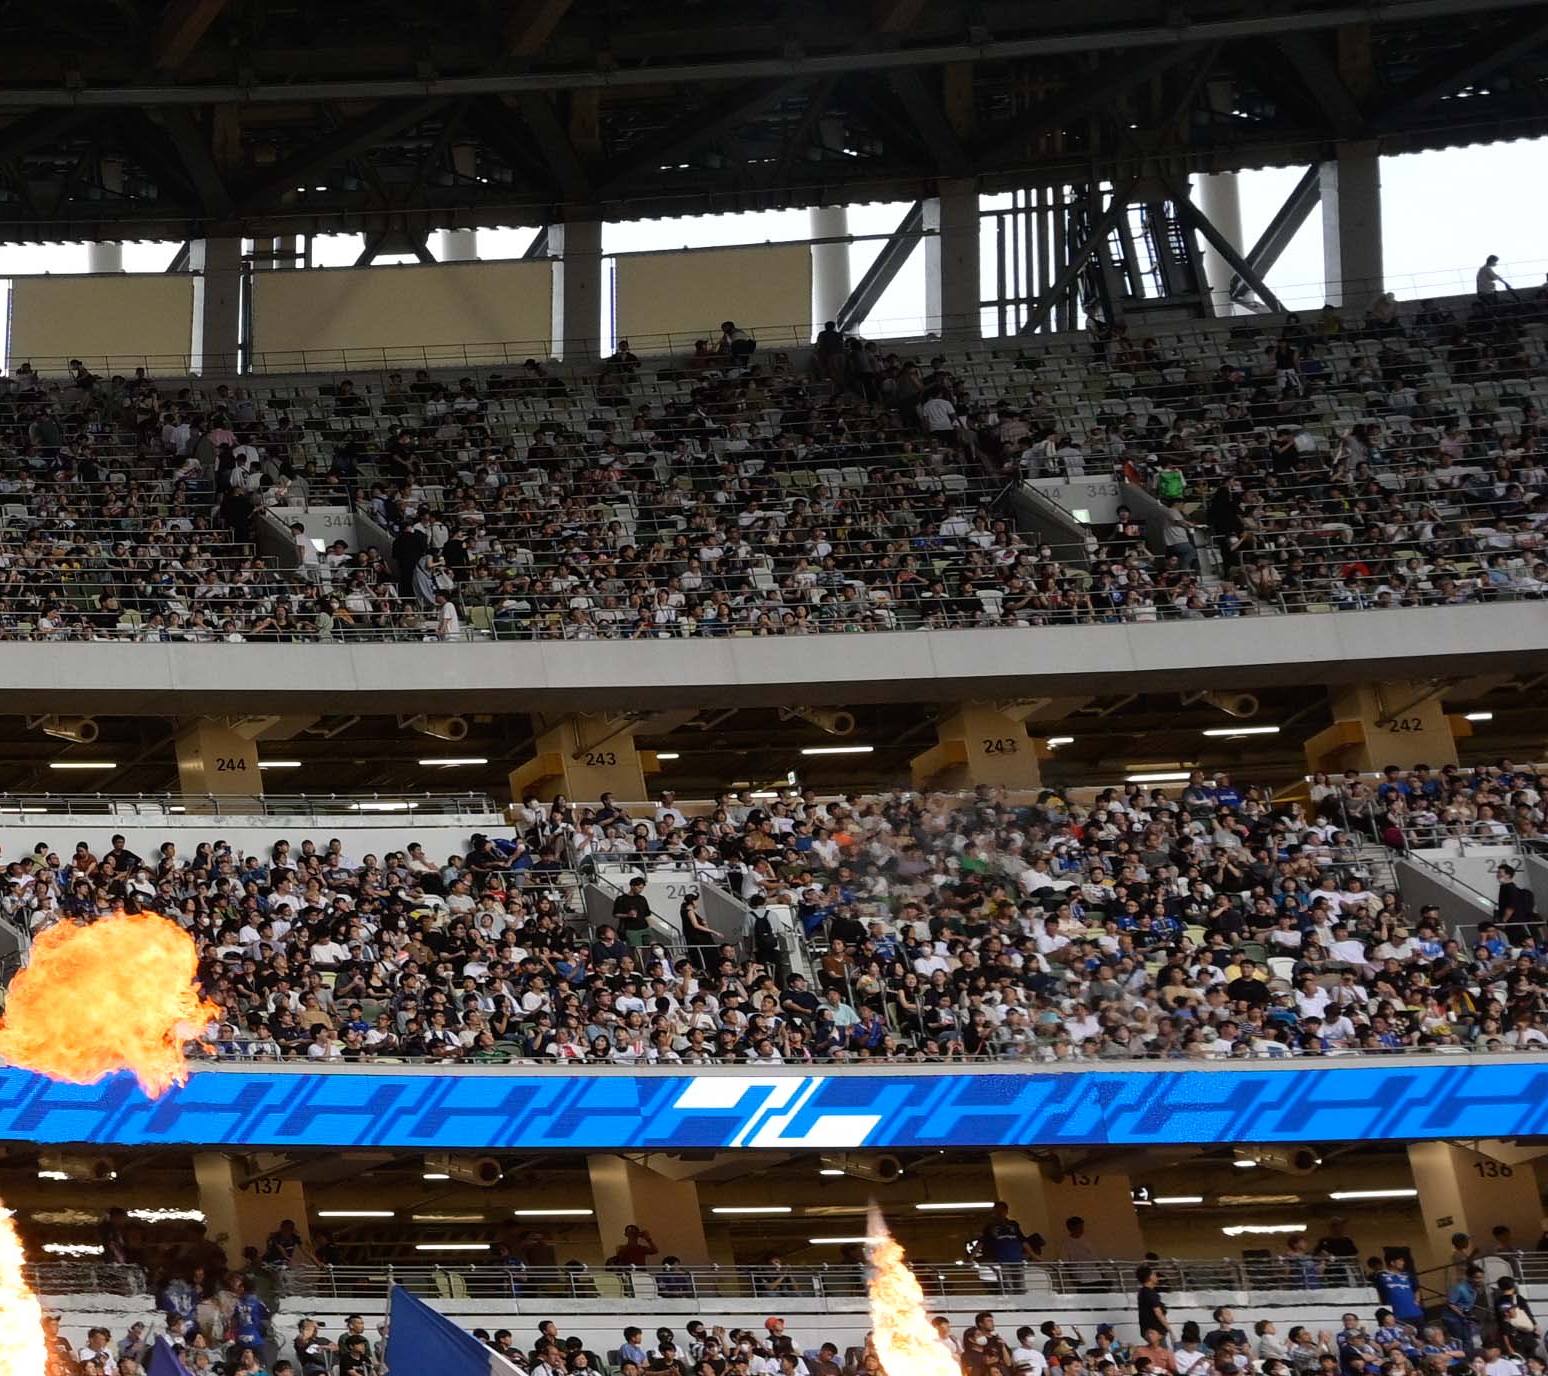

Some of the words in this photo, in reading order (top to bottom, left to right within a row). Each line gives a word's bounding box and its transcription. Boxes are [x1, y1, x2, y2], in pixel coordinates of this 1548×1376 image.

[1390, 718, 1424, 733] 242
[984, 738, 1018, 754] 243
[216, 758, 247, 771] 244
[585, 752, 617, 766] 243
[254, 1177, 283, 1195] 137
